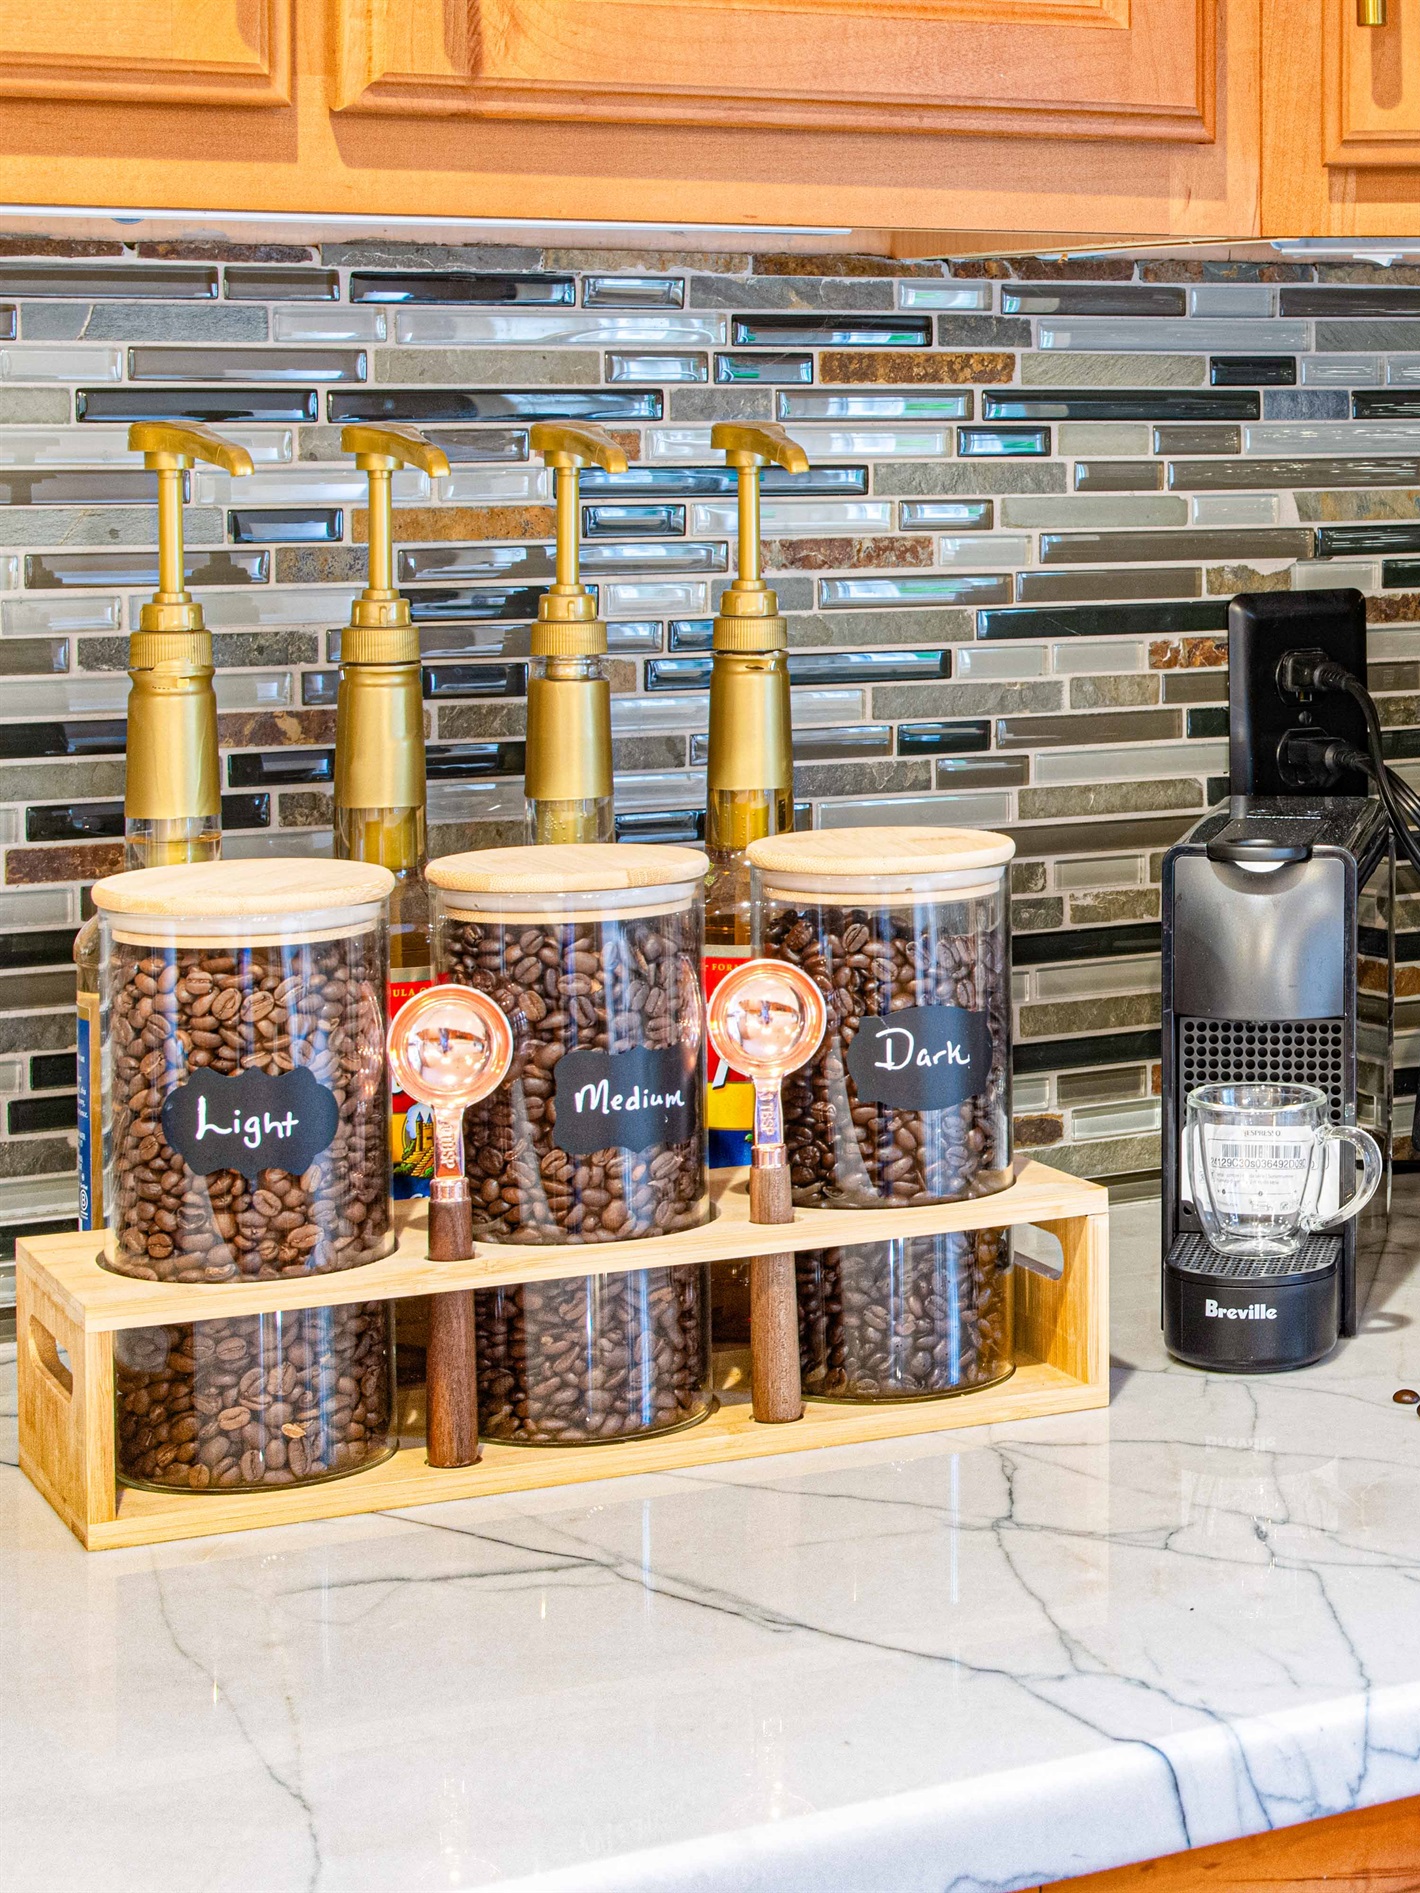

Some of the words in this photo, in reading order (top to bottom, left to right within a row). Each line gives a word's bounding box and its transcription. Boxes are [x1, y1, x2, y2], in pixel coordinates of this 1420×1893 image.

[874, 1027, 970, 1071] Dark
[574, 1079, 685, 1115] Medium
[195, 1095, 299, 1148] Light
[1204, 1298, 1278, 1320] Breville
